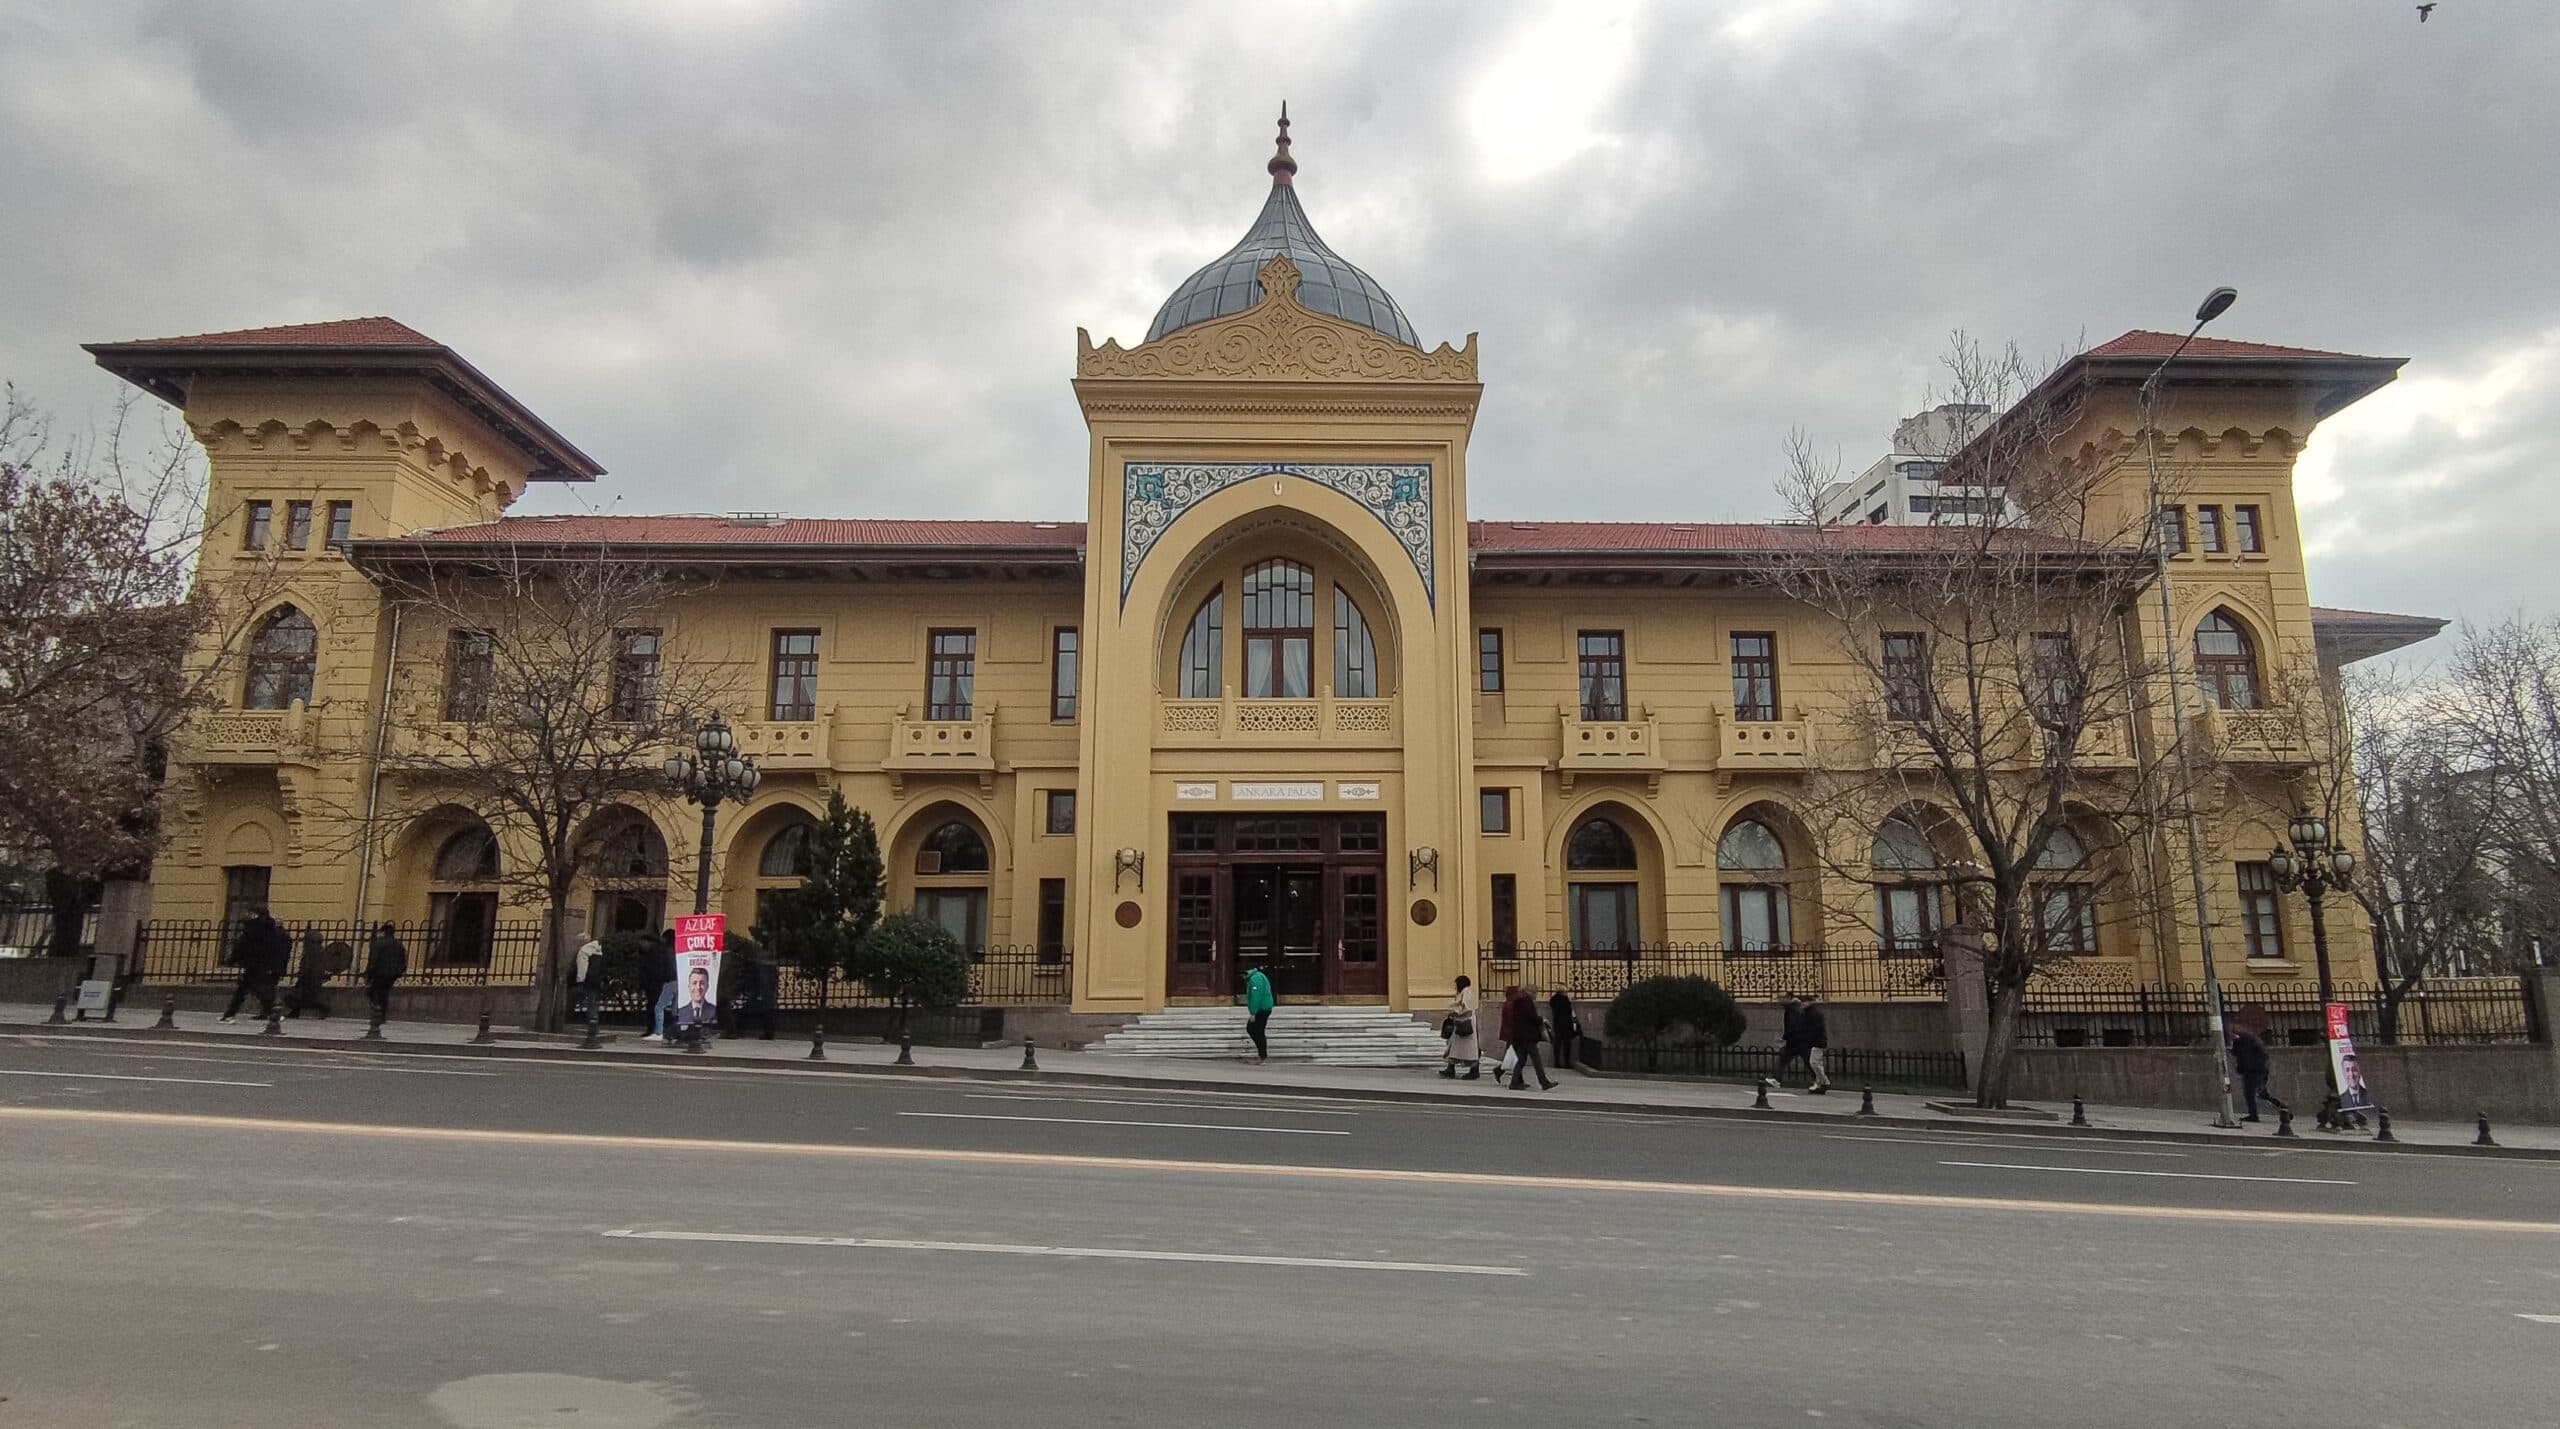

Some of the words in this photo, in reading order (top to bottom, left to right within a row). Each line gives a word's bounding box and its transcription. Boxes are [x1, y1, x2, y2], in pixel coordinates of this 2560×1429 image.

[1238, 786, 1285, 798] ANKARA
[1287, 786, 1319, 798] PALAS
[685, 918, 699, 932] AZ
[700, 917, 717, 931] LAF
